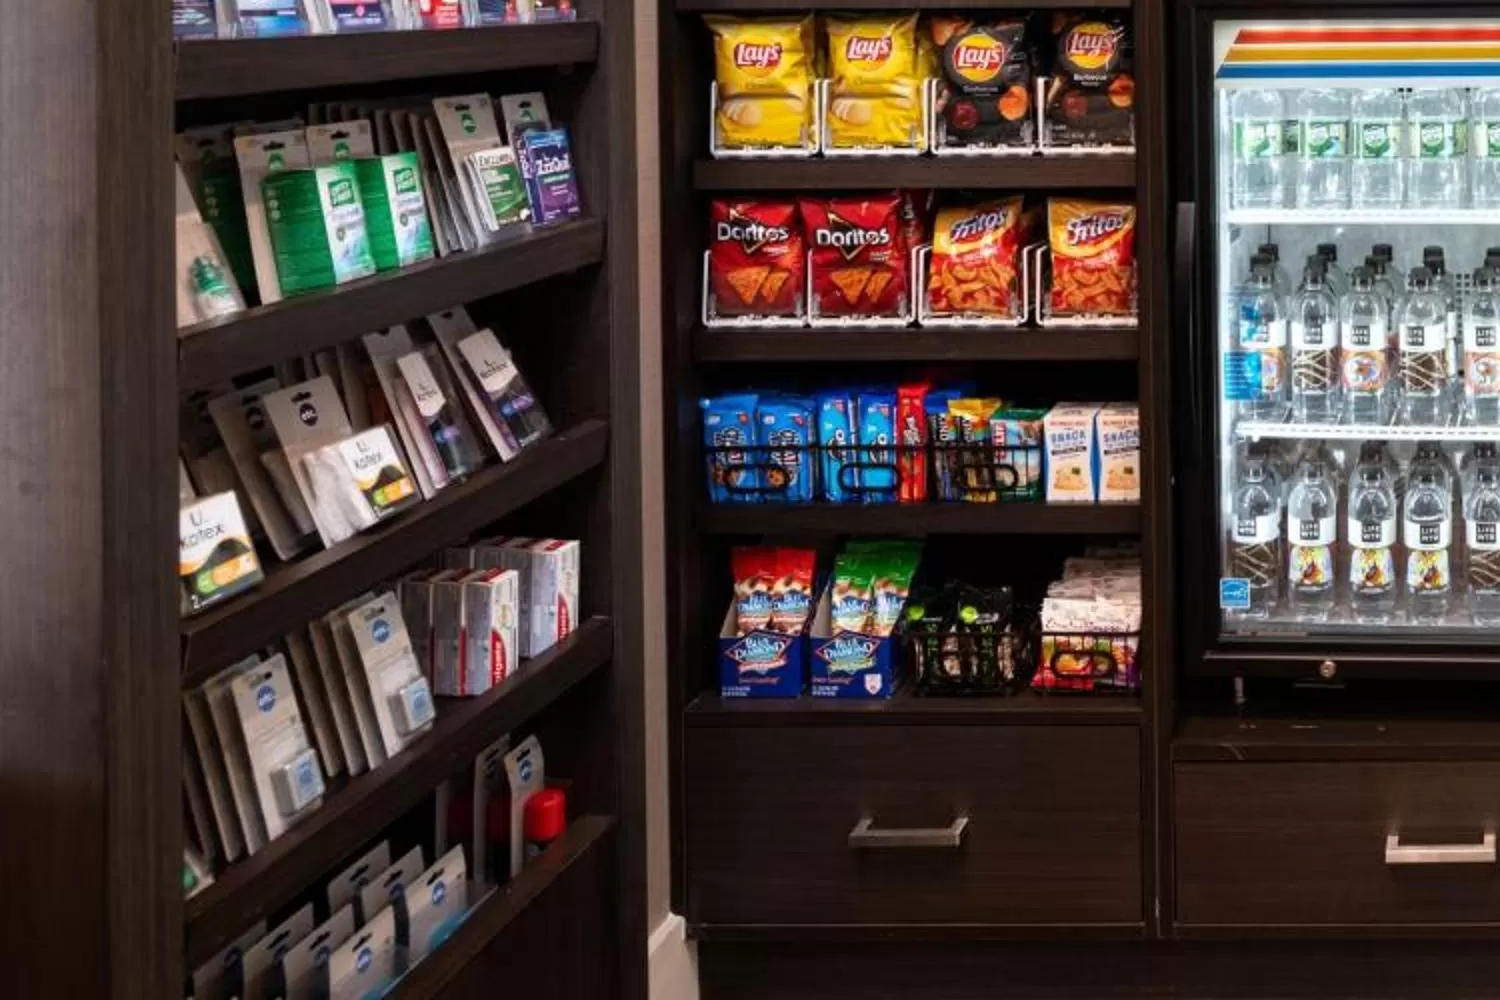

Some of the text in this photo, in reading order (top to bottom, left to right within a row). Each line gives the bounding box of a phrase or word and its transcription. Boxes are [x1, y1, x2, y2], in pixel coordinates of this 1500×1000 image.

[737, 43, 783, 67] Lay's
[847, 37, 892, 60] Lay's
[1069, 33, 1115, 55] Lay's
[958, 46, 1001, 69] Lay's
[717, 222, 789, 241] Doritos
[816, 227, 891, 245] Doritos
[951, 210, 1005, 240] Fritos
[1067, 213, 1125, 244] Fritos
[1051, 430, 1087, 444] SNACK
[1103, 430, 1140, 443] SNACK
[353, 450, 383, 471] kotex
[180, 523, 224, 552] kotex
